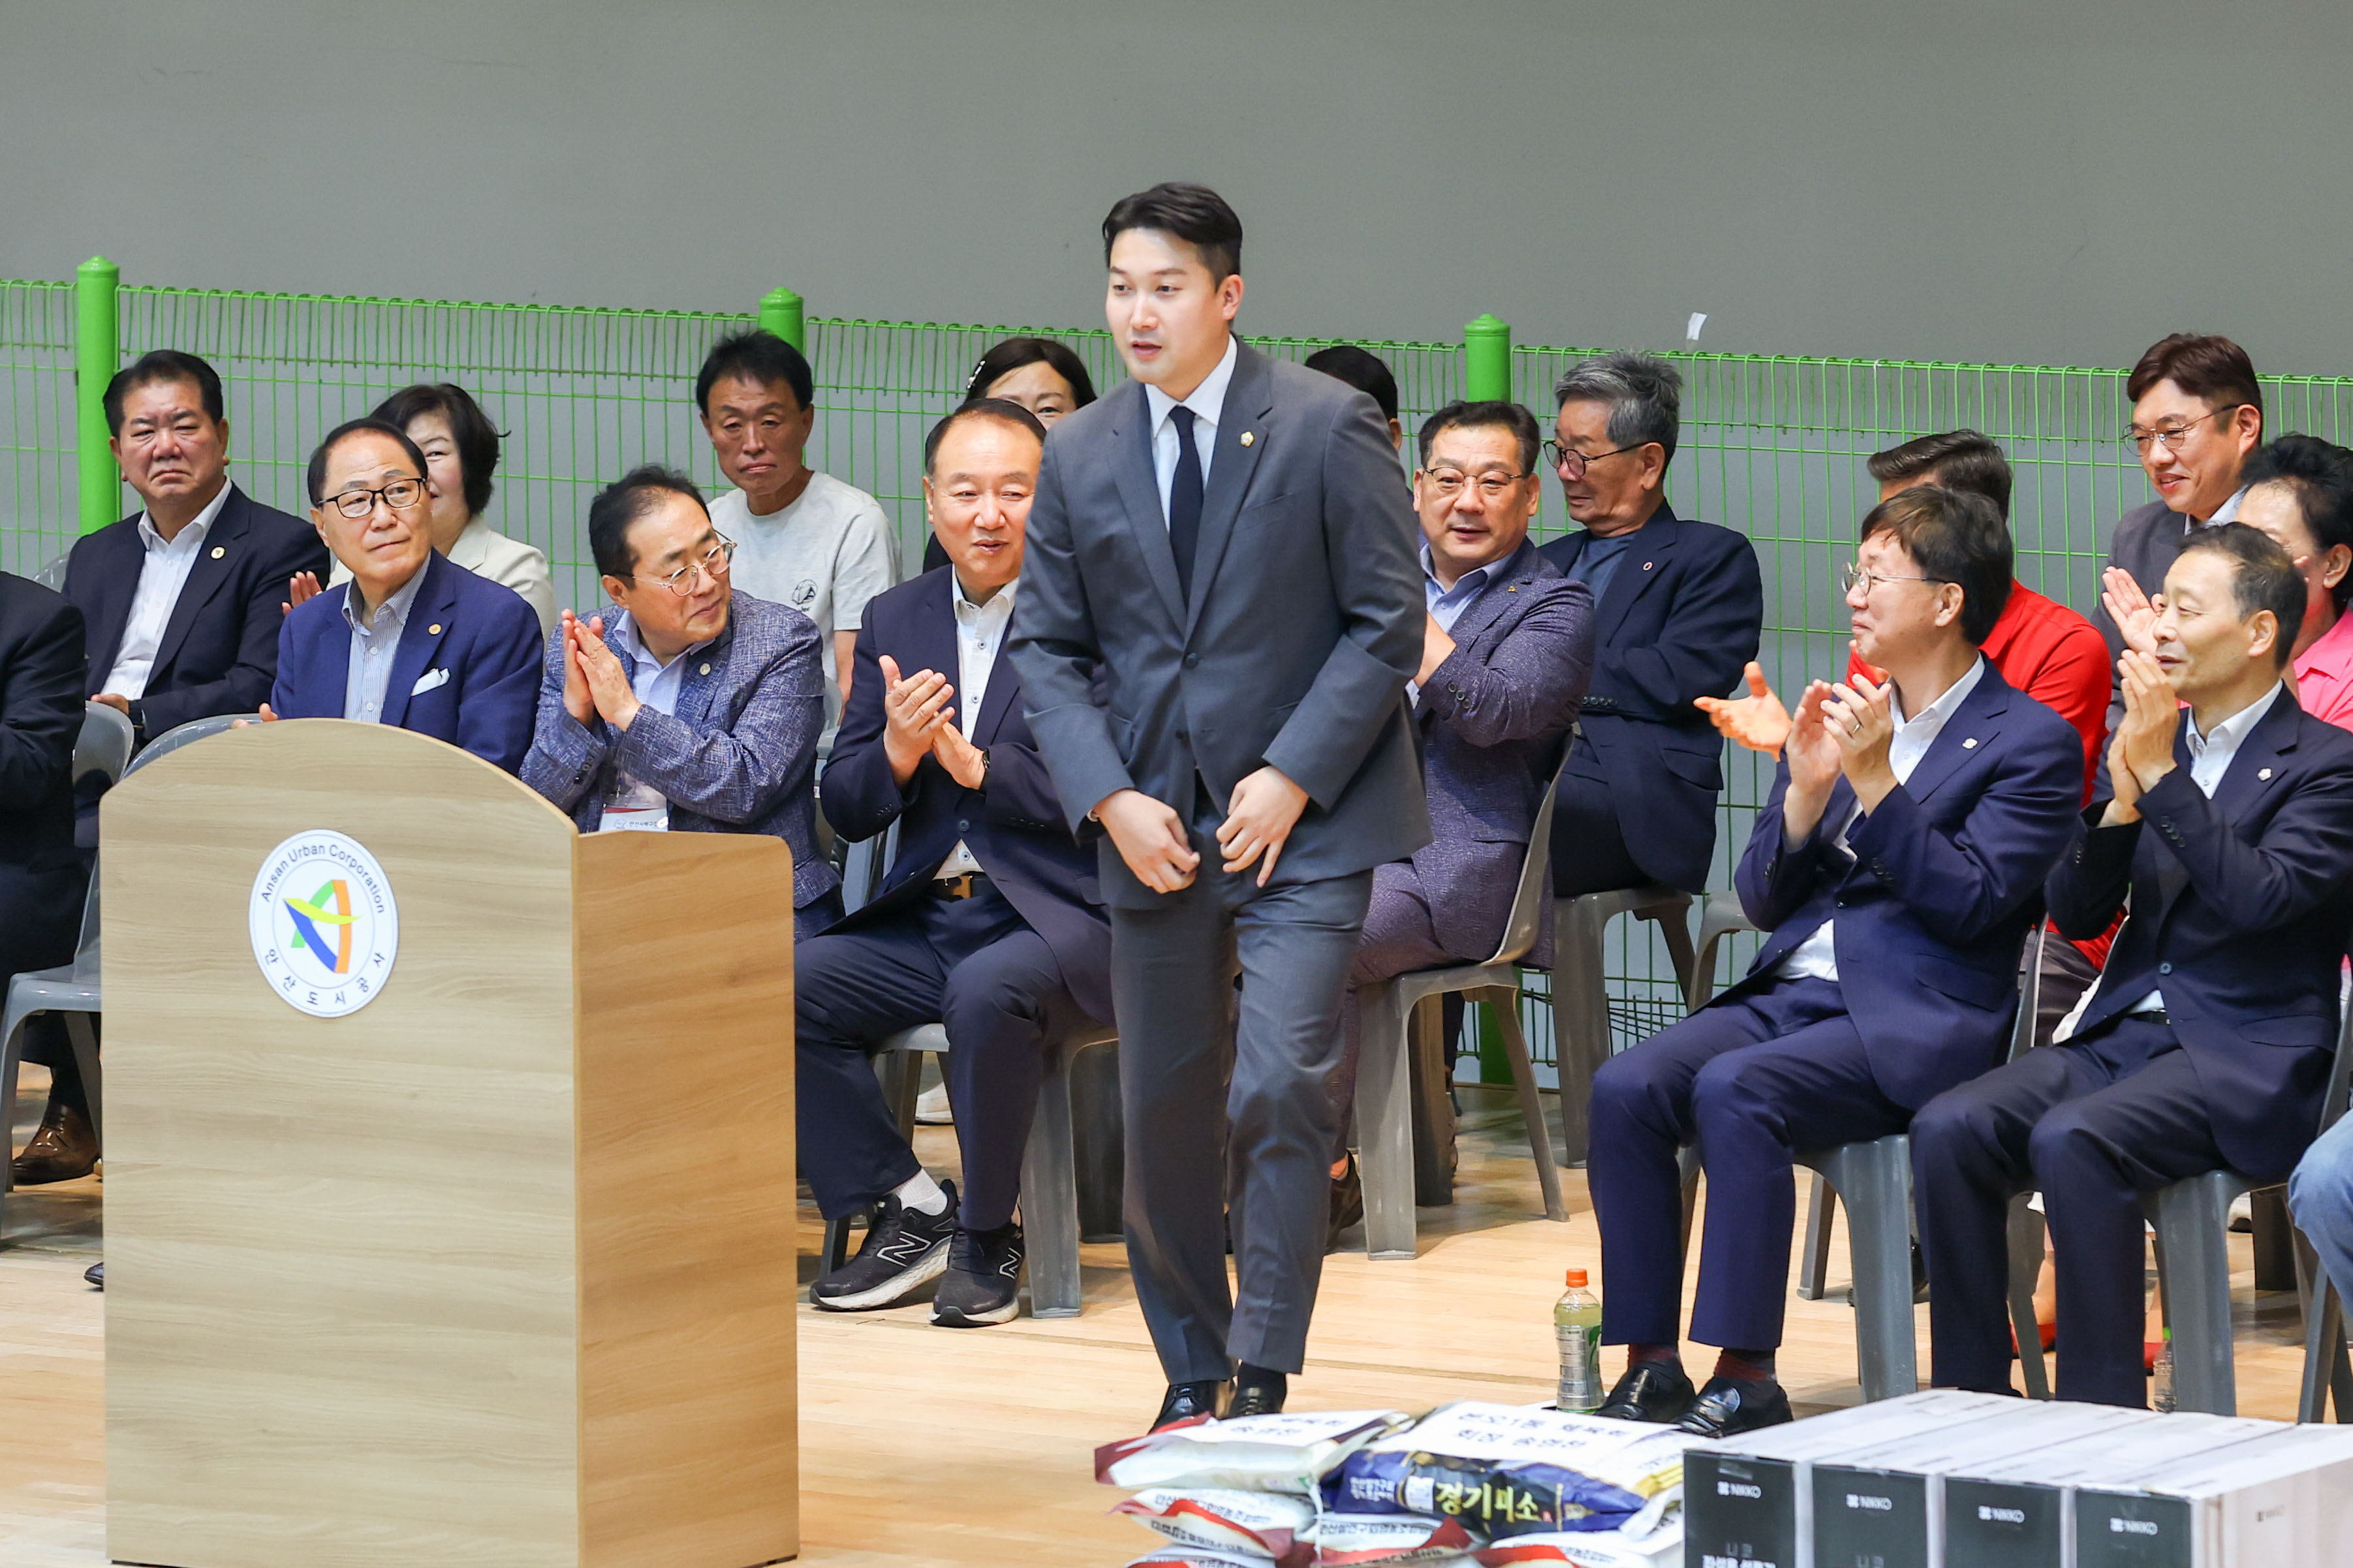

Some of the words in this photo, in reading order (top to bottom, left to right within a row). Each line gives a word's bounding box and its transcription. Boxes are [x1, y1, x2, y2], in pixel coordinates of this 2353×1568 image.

[262, 860, 288, 902] Ansan
[288, 844, 325, 863] Urban
[329, 844, 385, 914] Corporation
[265, 949, 385, 1006] 안산도시공사
[1730, 1483, 1762, 1498] NIKKO
[1435, 1481, 1542, 1523] 경기미소
[1860, 1495, 1892, 1511] NIKKO
[1991, 1507, 2025, 1523] NIKKO
[2123, 1520, 2158, 1535] NIKKO
